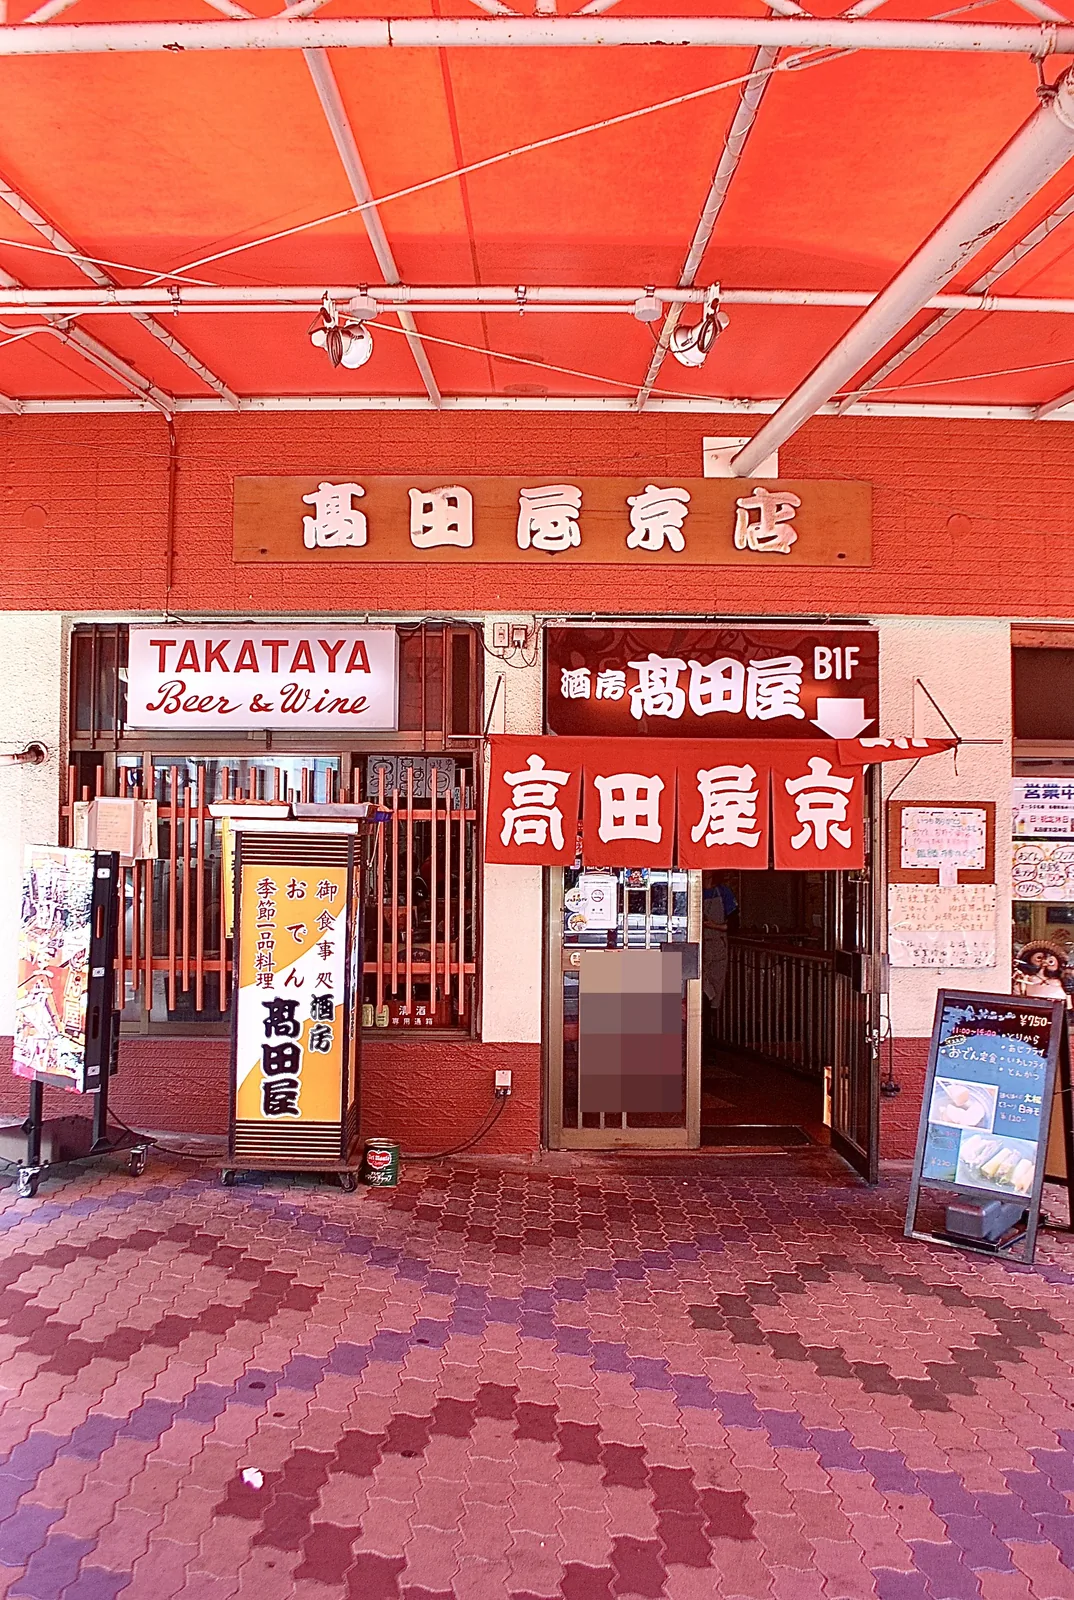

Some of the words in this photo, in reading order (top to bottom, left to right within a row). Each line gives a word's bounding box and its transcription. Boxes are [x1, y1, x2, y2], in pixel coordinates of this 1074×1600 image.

[150, 640, 371, 674] TAKATAYA
[814, 646, 860, 680] B1F
[146, 680, 243, 714] Beer
[249, 693, 275, 713] &
[280, 683, 371, 714] Wine
[560, 668, 627, 701] 酒房
[500, 754, 855, 850] 高田屋京
[255, 877, 279, 990] 季節一品料理
[284, 878, 307, 988] おでん
[315, 880, 338, 989] 御食事処
[310, 993, 336, 1053] 酒房
[1006, 1032, 1041, 1045] とりから
[948, 1046, 998, 1065] おでん定食
[1006, 1068, 1040, 1080] とんかつ
